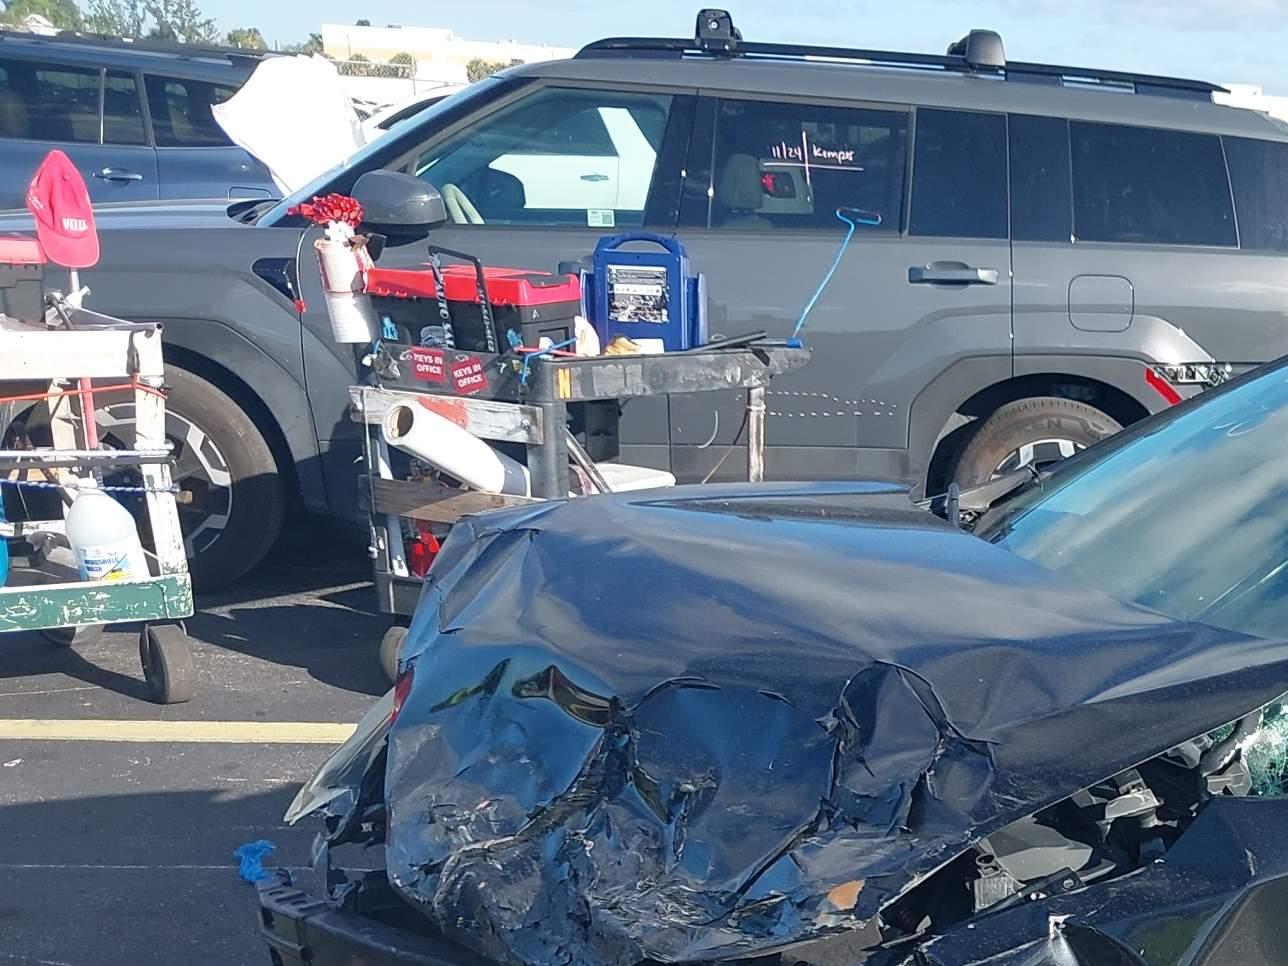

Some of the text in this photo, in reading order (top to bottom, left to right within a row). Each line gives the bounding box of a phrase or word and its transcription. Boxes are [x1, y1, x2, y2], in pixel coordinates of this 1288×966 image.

[772, 141, 802, 161] 11/24
[413, 353, 443, 365] KEYS IN
[416, 363, 442, 375] OFFICE
[453, 363, 482, 379] KEYS IN
[458, 374, 484, 388] OFFICE
